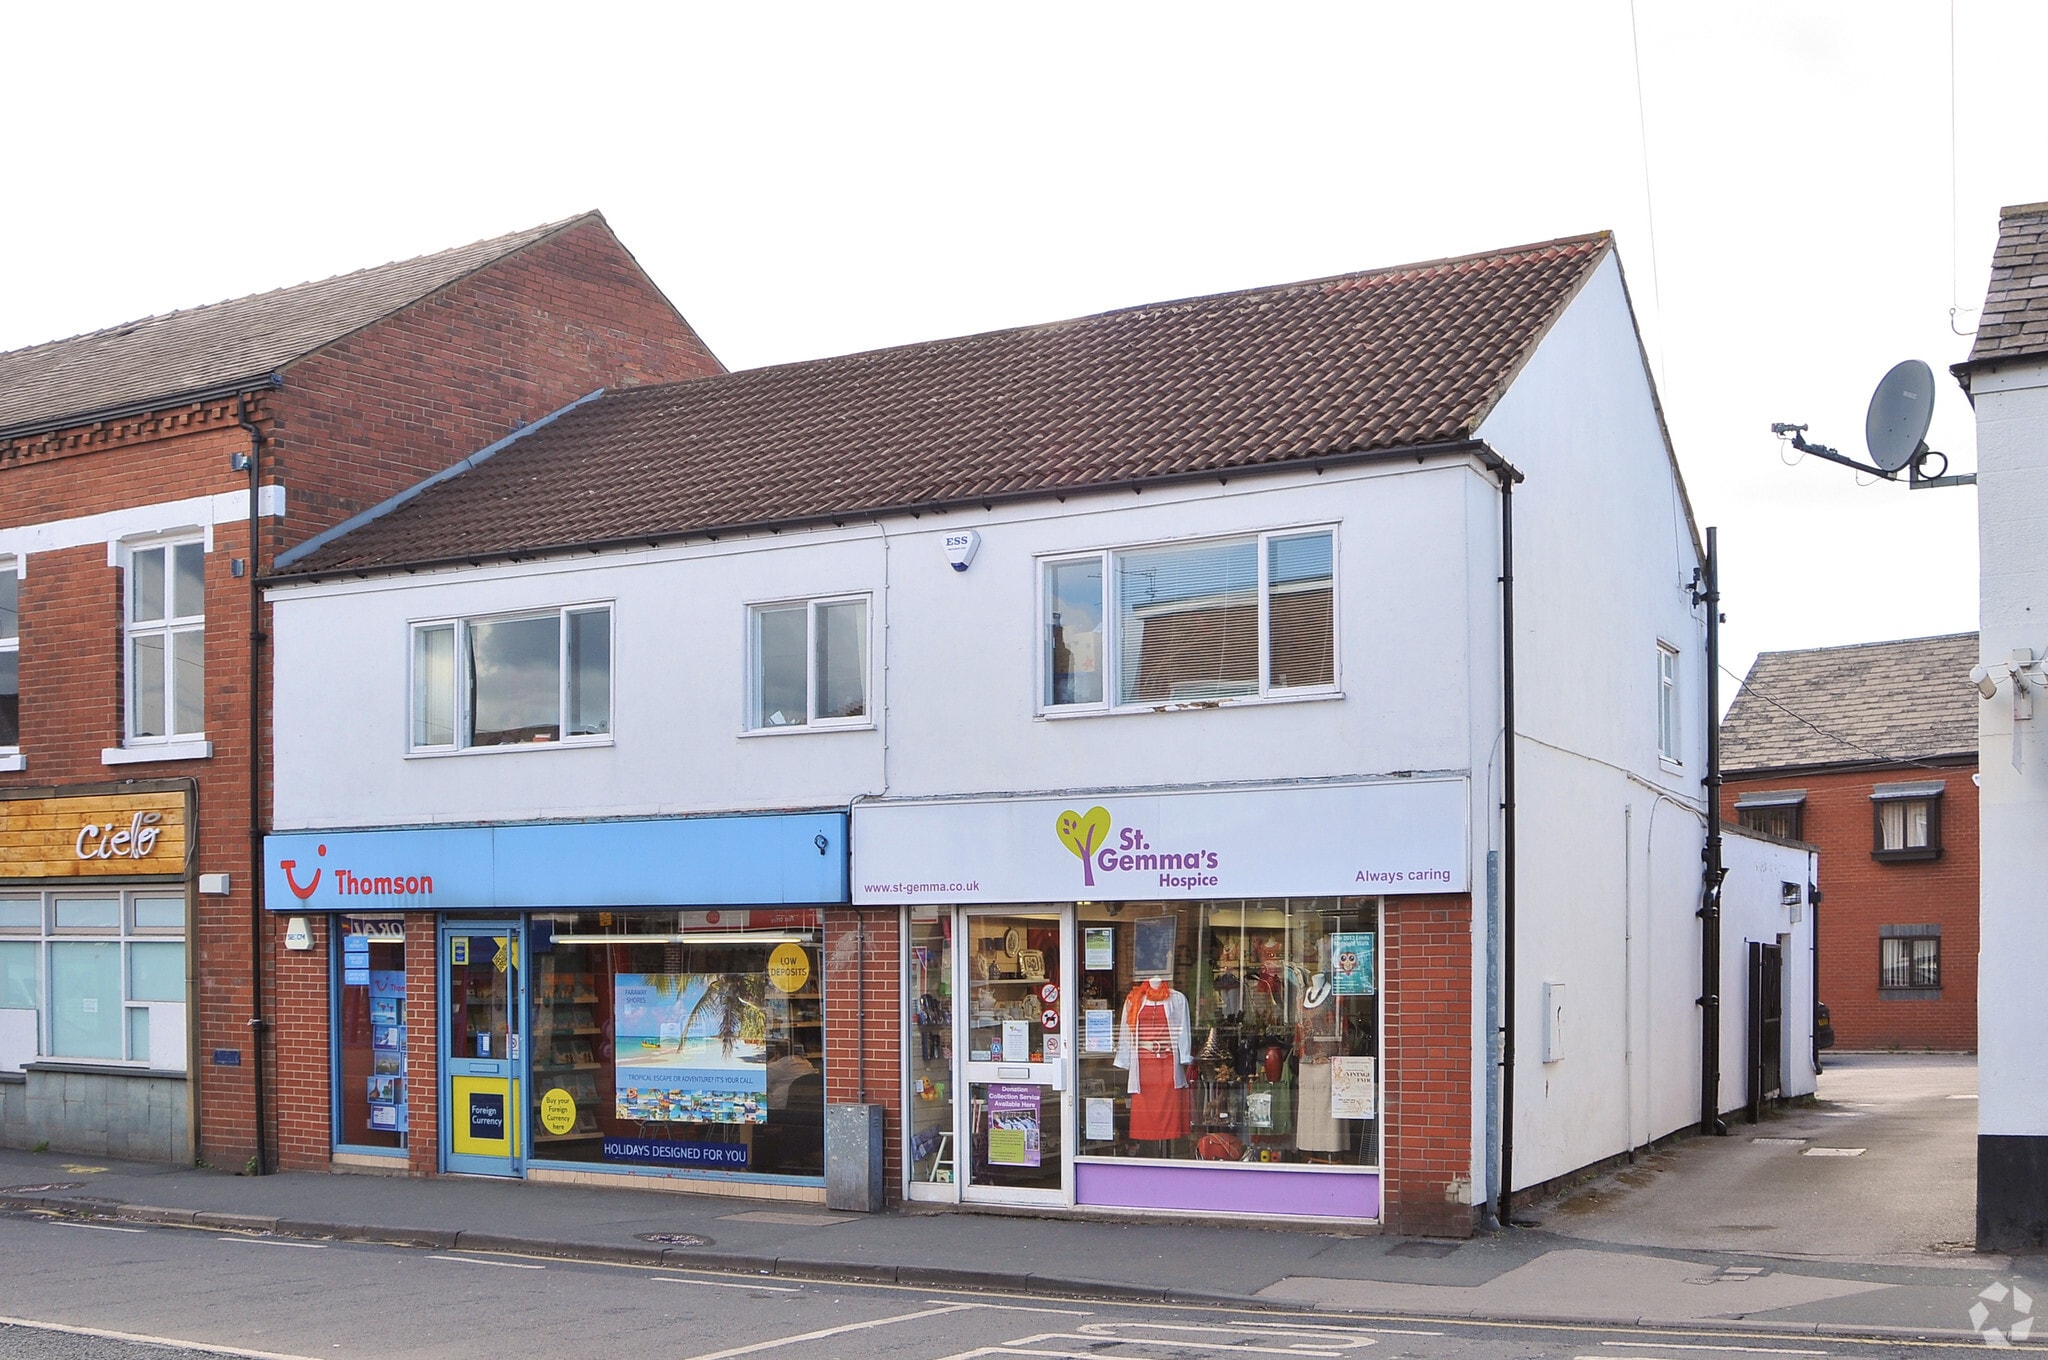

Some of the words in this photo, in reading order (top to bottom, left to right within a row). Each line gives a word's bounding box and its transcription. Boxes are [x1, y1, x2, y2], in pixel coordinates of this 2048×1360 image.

[946, 536, 968, 546] ESS
[76, 810, 161, 859] Cielo
[1119, 827, 1150, 850] St.
[1097, 848, 1219, 872] Gemma's
[334, 869, 433, 895] Thomson
[1159, 872, 1219, 890] Hospice
[1355, 870, 1404, 884] Always
[1408, 868, 1451, 882] caring
[864, 880, 980, 895] www.st-gemma.co.uk
[780, 957, 797, 965] LOW
[770, 968, 807, 976] DEPOSITS
[628, 1074, 653, 1082] TROPICAL
[681, 1075, 714, 1083] ADVENTURE?
[725, 1076, 739, 1084] YOUR
[471, 1105, 497, 1116] Foreign
[994, 1100, 1020, 1108] Available
[471, 1116, 503, 1127] Currency
[546, 1114, 570, 1122] Currency
[604, 1143, 650, 1156] HOLIDAYS
[652, 1146, 700, 1159] DESIGNED
[703, 1148, 723, 1161] FOR
[726, 1150, 747, 1162] YOU
